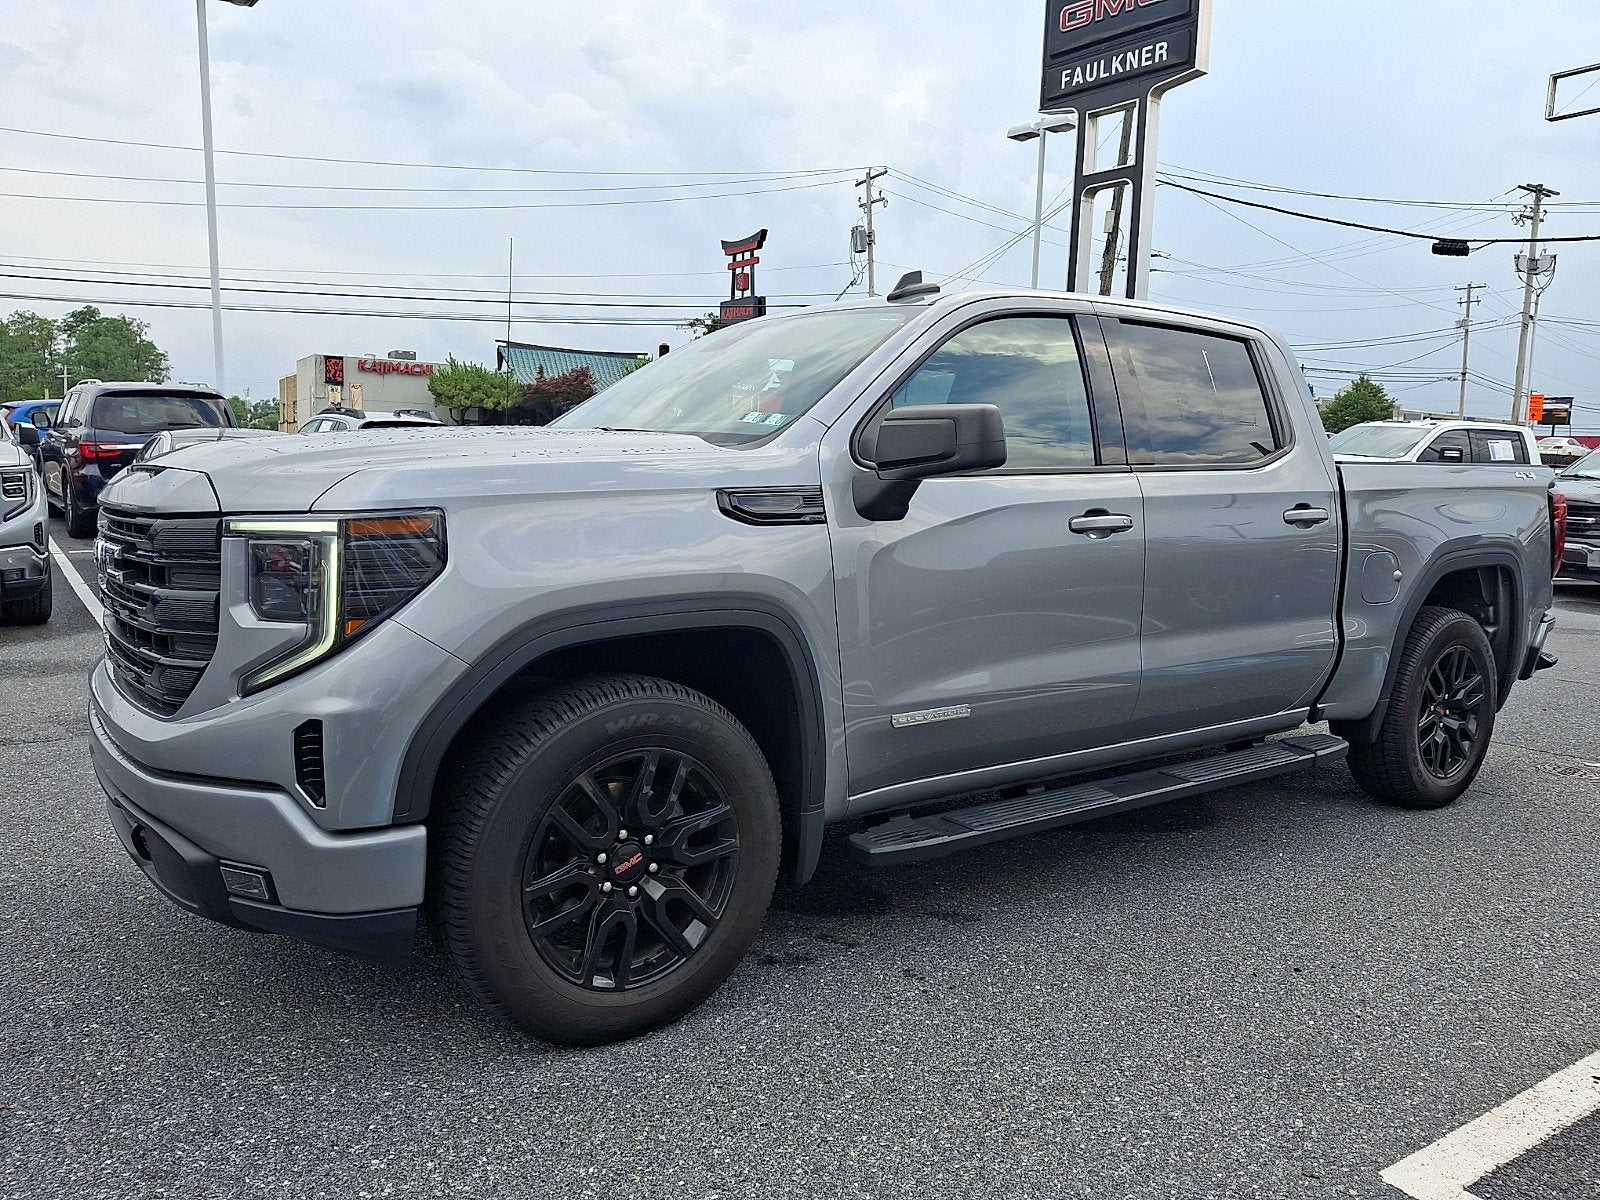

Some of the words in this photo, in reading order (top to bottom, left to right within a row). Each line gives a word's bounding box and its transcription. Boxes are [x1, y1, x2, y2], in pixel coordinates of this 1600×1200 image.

[1060, 0, 1167, 32] GM
[1061, 41, 1168, 90] FAULKNER
[614, 852, 643, 875] GMC
